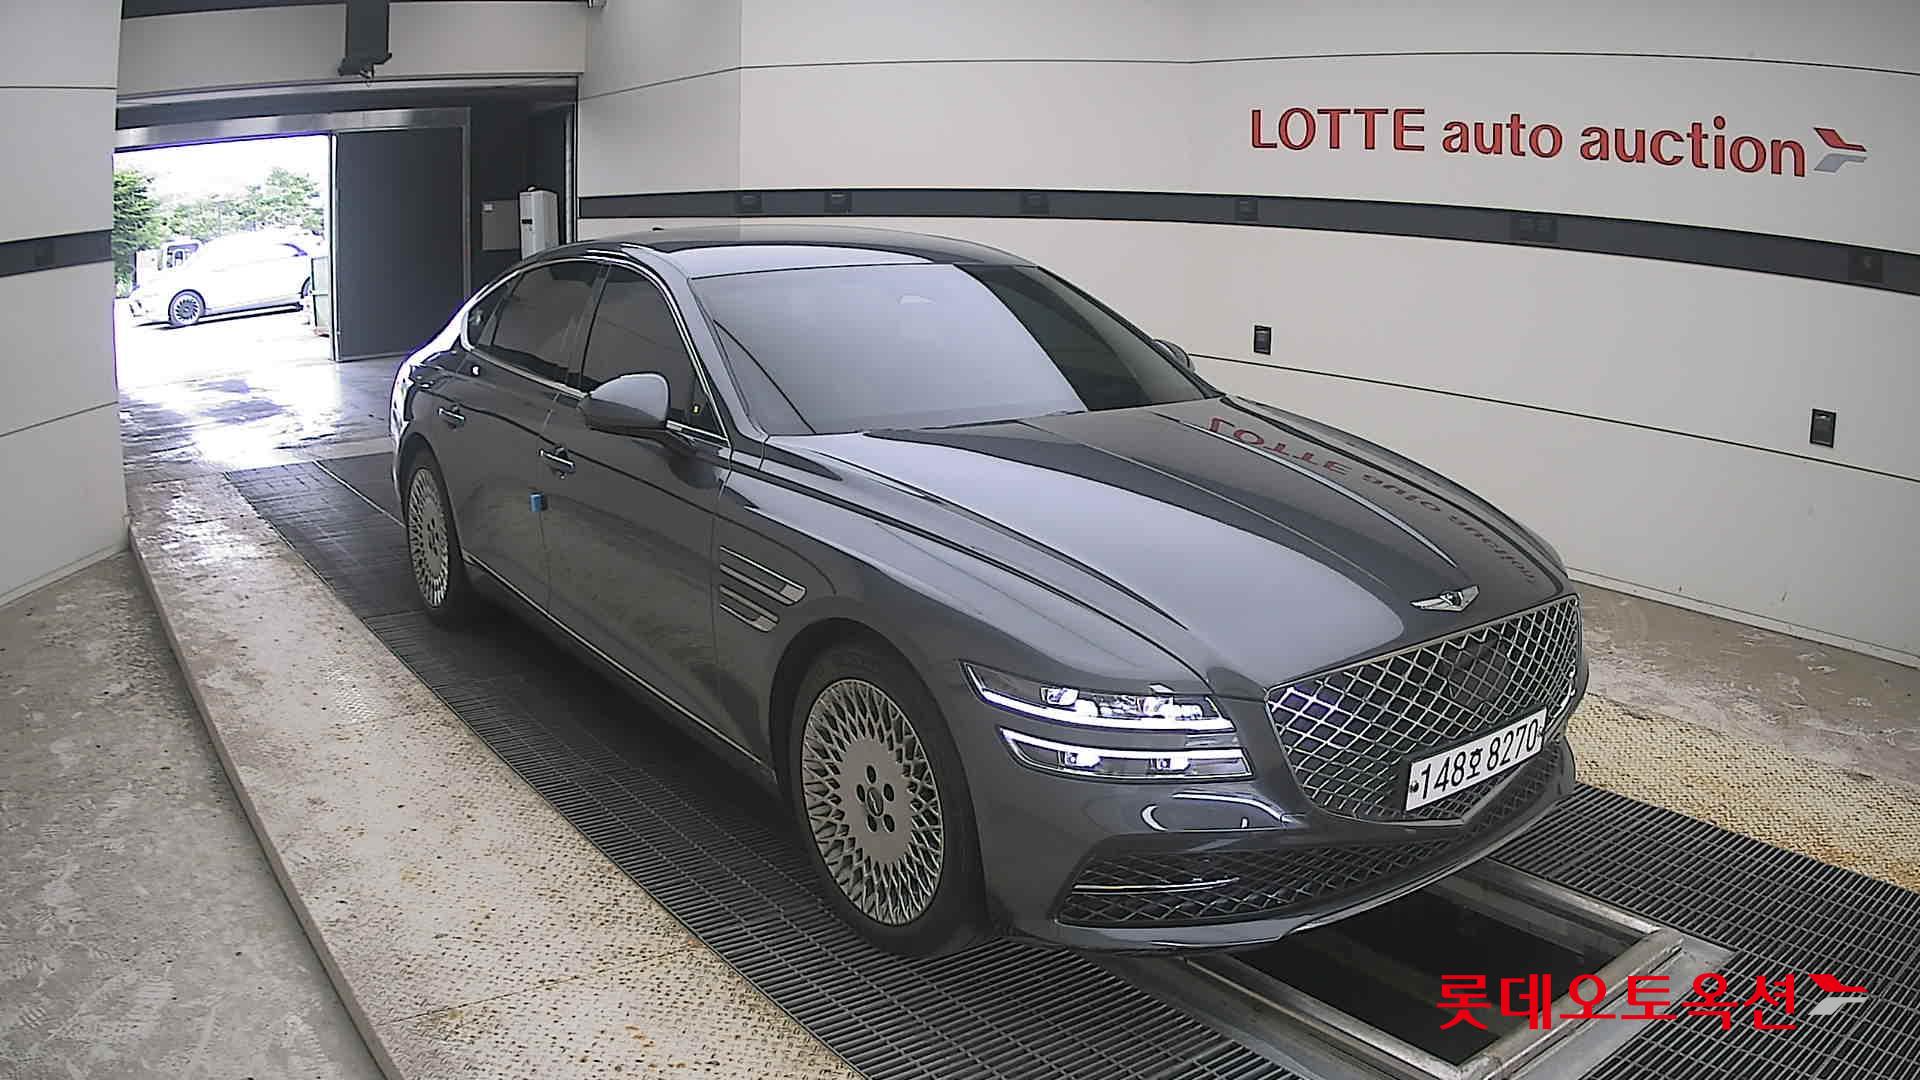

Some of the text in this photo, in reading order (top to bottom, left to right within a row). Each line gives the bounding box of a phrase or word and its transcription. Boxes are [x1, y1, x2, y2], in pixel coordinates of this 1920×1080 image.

[1250, 107, 1807, 178] LOTTE auto auction
[1420, 718, 1539, 800] 148호 8270
